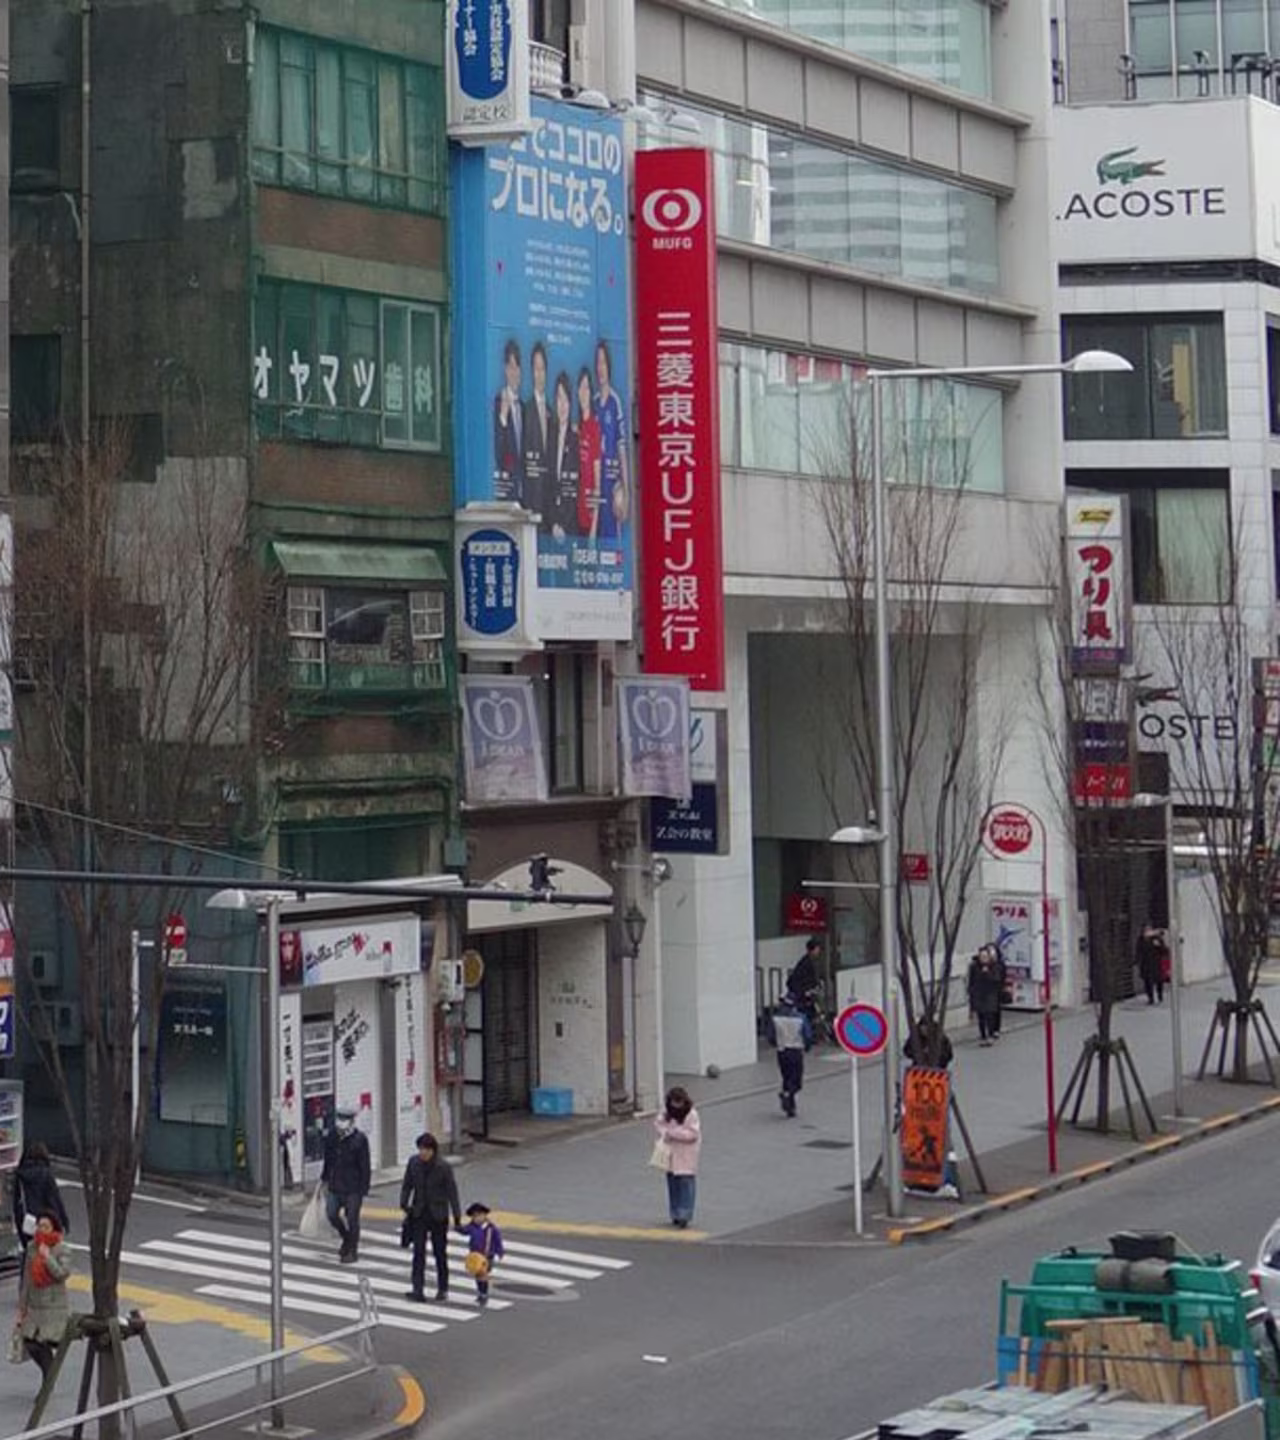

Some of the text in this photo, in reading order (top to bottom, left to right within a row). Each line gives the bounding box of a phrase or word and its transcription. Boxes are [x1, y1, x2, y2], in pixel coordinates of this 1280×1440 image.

[511, 117, 622, 175] でココロの
[489, 156, 625, 236] プロになる。
[1055, 188, 1226, 220] ACOSTE
[652, 237, 693, 249] MUFG
[656, 312, 700, 652] 三菱東京UFJ銀行
[1077, 544, 1114, 641] つり具
